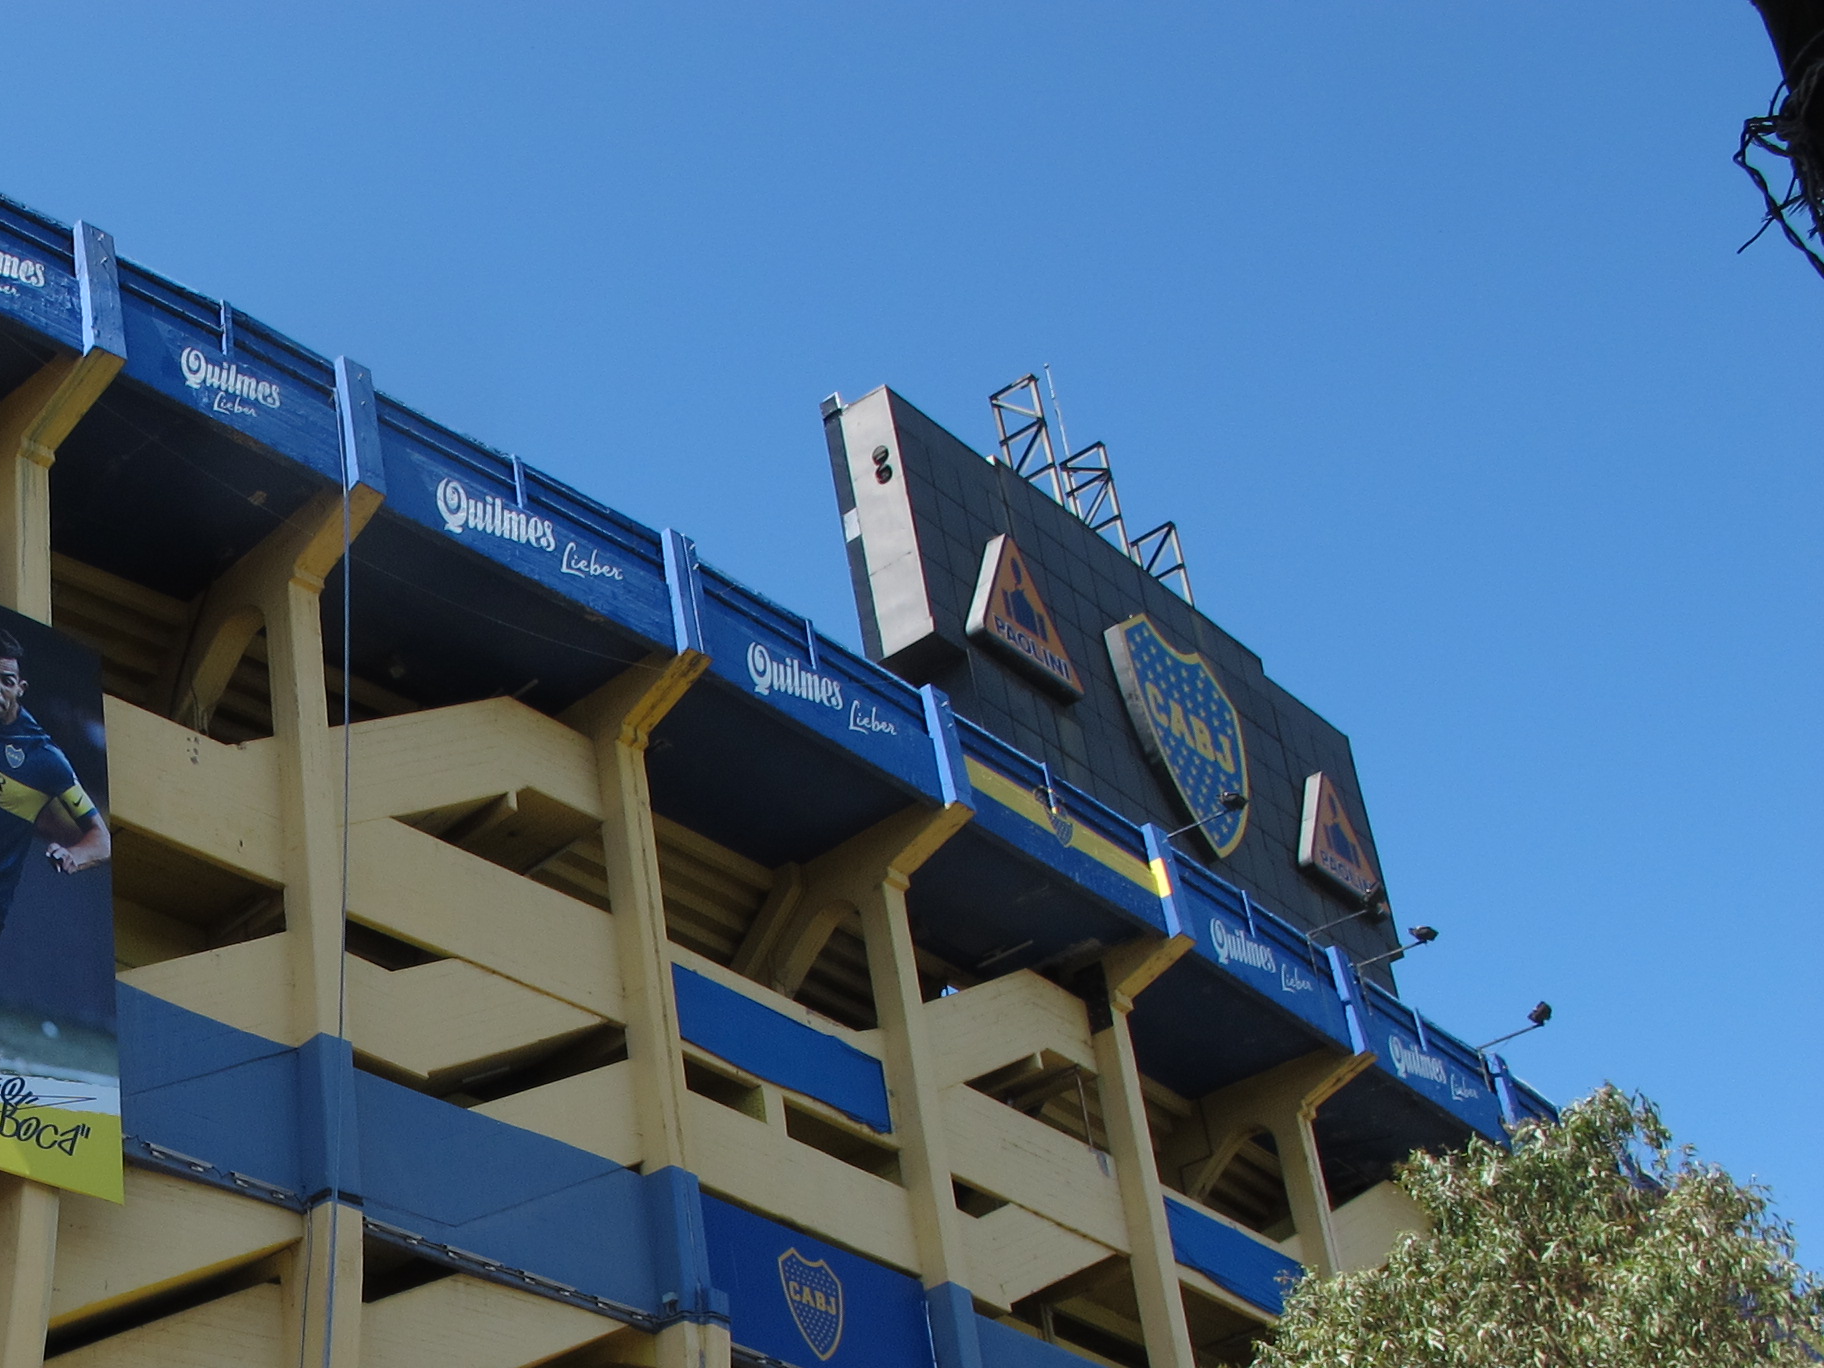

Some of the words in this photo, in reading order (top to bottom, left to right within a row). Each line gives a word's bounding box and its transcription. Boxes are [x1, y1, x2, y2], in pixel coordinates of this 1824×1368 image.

[181, 346, 281, 408] Quilmes
[213, 390, 256, 417] Lieber
[436, 477, 556, 552] Quilmes
[561, 542, 623, 581] Lieber
[993, 613, 1072, 682] PAOLINI
[747, 641, 843, 711] Quilmes
[848, 700, 897, 735] Lieber
[1145, 681, 1235, 774] CABJ
[1210, 918, 1276, 973] Quilmes
[1281, 963, 1313, 993] Lieber
[1389, 1034, 1447, 1084] Quilmes
[788, 1281, 837, 1316] CABJ
